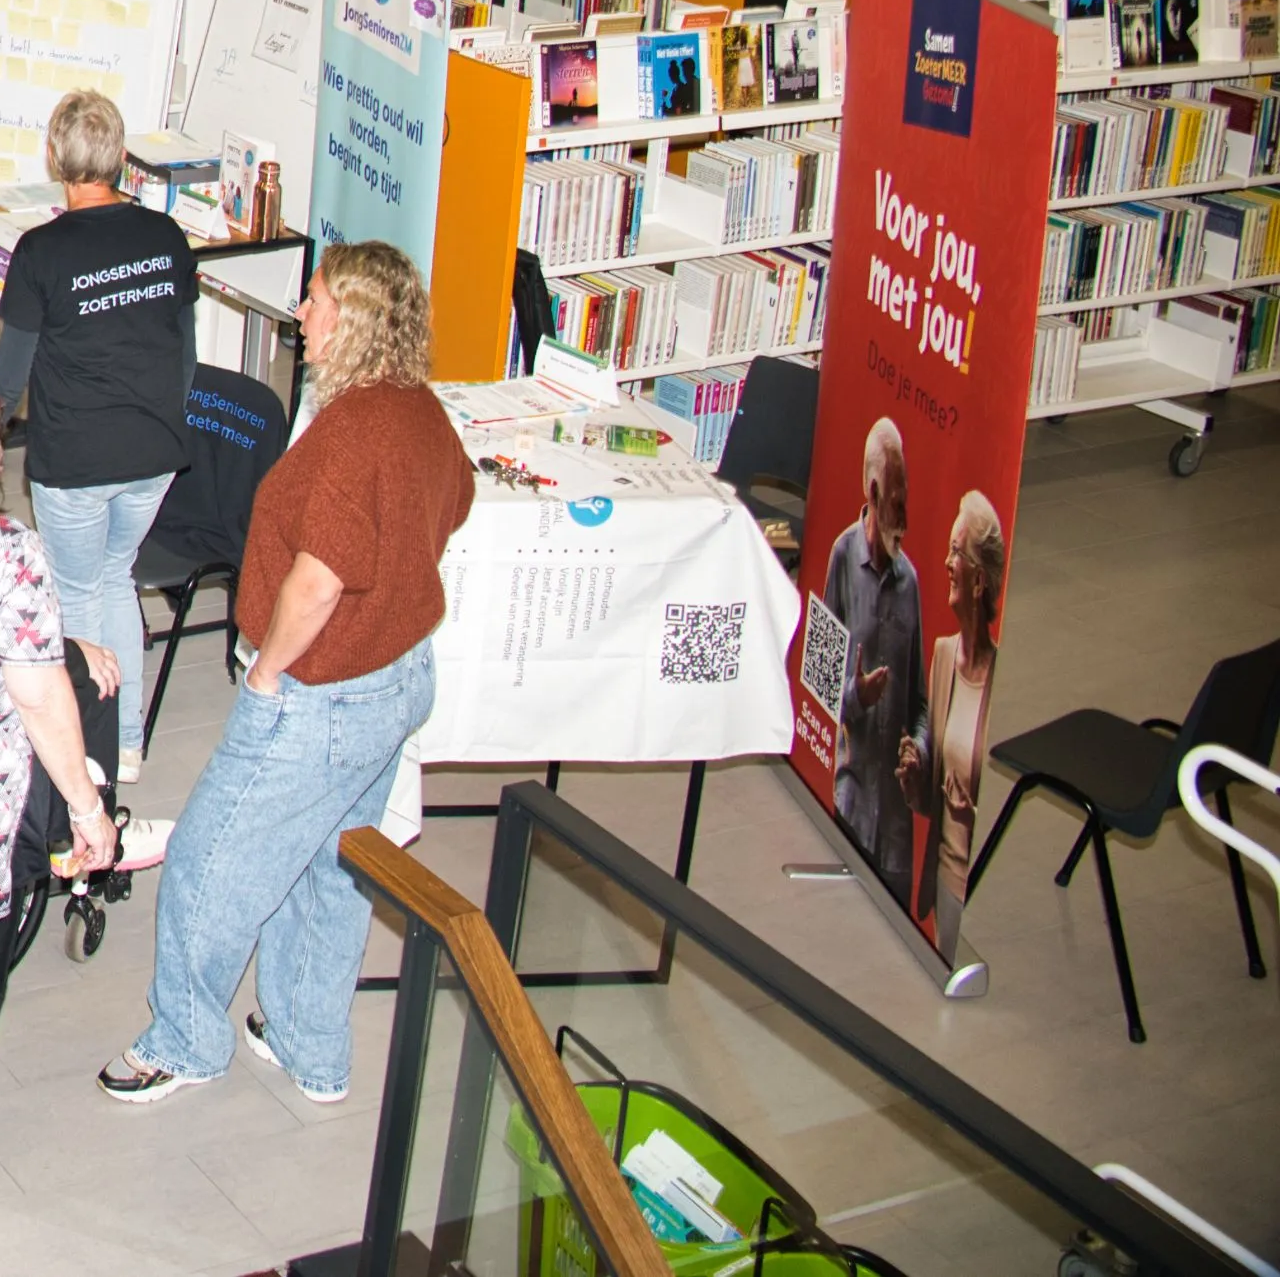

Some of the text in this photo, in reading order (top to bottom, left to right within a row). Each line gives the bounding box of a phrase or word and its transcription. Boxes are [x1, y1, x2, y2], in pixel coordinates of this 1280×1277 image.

[344, 1, 413, 56] JongSeniorenZM
[924, 27, 955, 54] Samen
[915, 51, 967, 86] ZoeterMEER
[323, 59, 424, 146] Wie prettig oud wil
[328, 132, 402, 206] begint op tijd!
[349, 115, 390, 165] worden,
[875, 168, 981, 305] Voor jou,
[71, 255, 173, 292] JONGSENIOREN
[78, 282, 175, 316] ZOETERMEER
[867, 254, 976, 376] met jou!
[867, 339, 958, 437] Doe je mee?
[451, 565, 468, 623] Zinvol leven
[501, 566, 522, 662] Gevoel van controle
[533, 566, 554, 649] Jezelf accepteren
[552, 566, 570, 617] Vrolijk zijn
[565, 566, 585, 641] Communiceren
[582, 566, 600, 632] Concentreren
[598, 566, 616, 621] Onthouden
[512, 566, 538, 687] Omgaan met verandering
[795, 716, 833, 772] QR-Code!
[801, 700, 832, 747] Scan de
